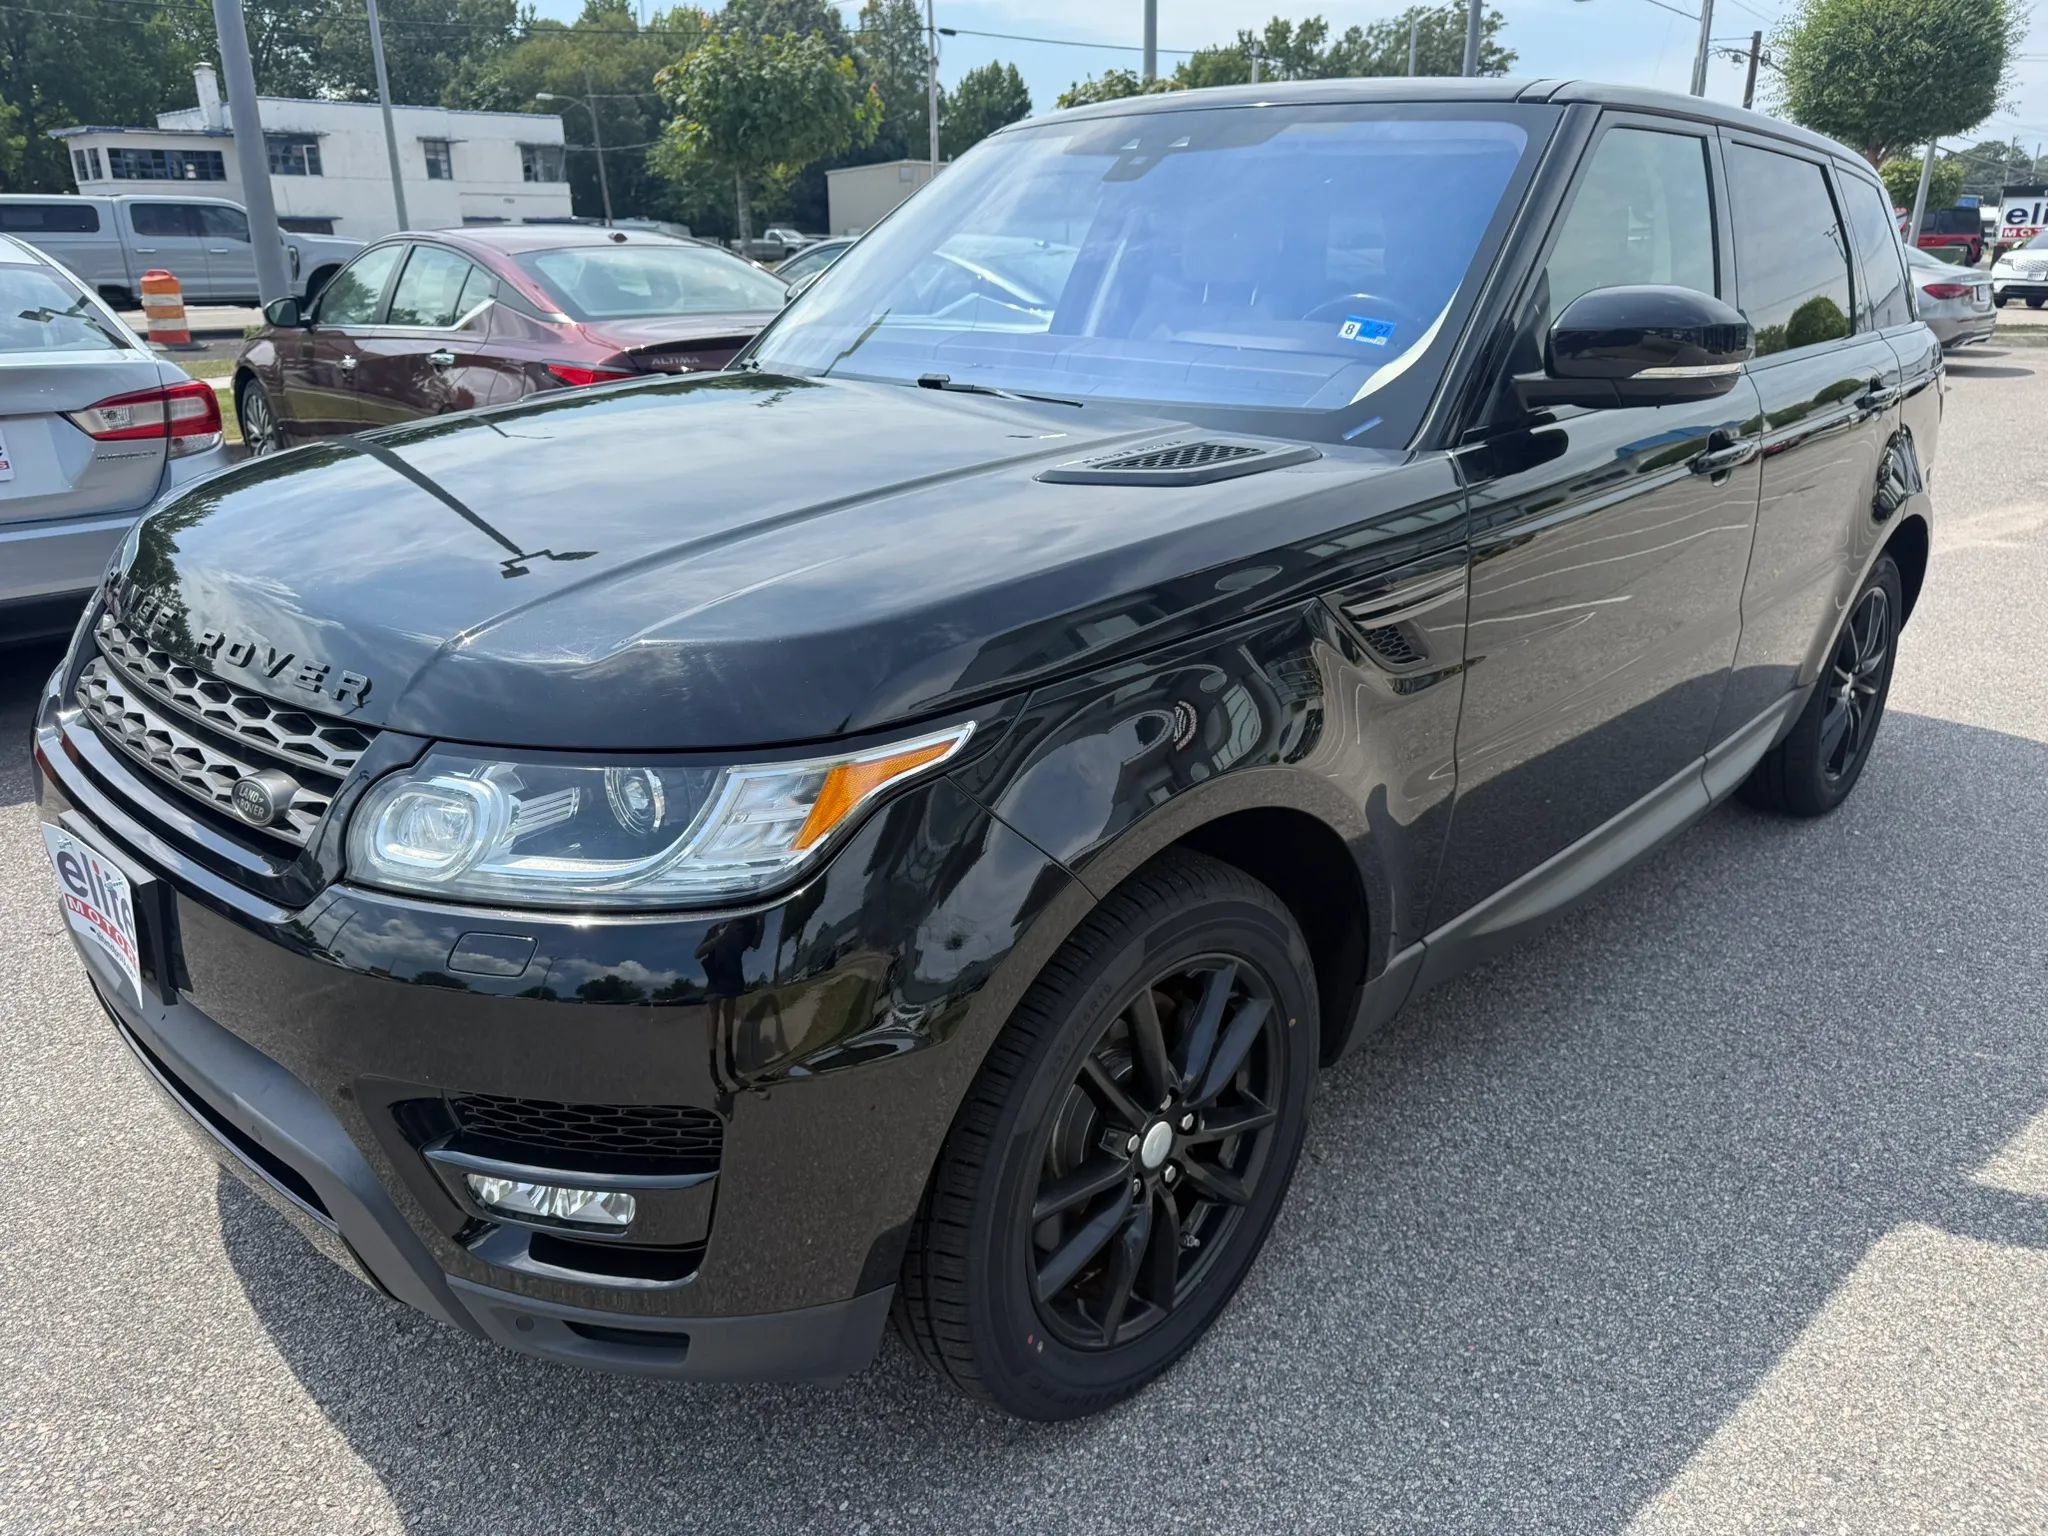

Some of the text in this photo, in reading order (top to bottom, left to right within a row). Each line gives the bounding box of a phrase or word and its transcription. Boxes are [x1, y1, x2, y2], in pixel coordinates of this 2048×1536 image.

[1345, 323, 1355, 335] 8
[652, 356, 700, 365] ALTIMA
[198, 628, 373, 708] ROVER
[238, 784, 260, 803] LAND
[240, 799, 265, 818] ROVER
[56, 850, 137, 953] elite
